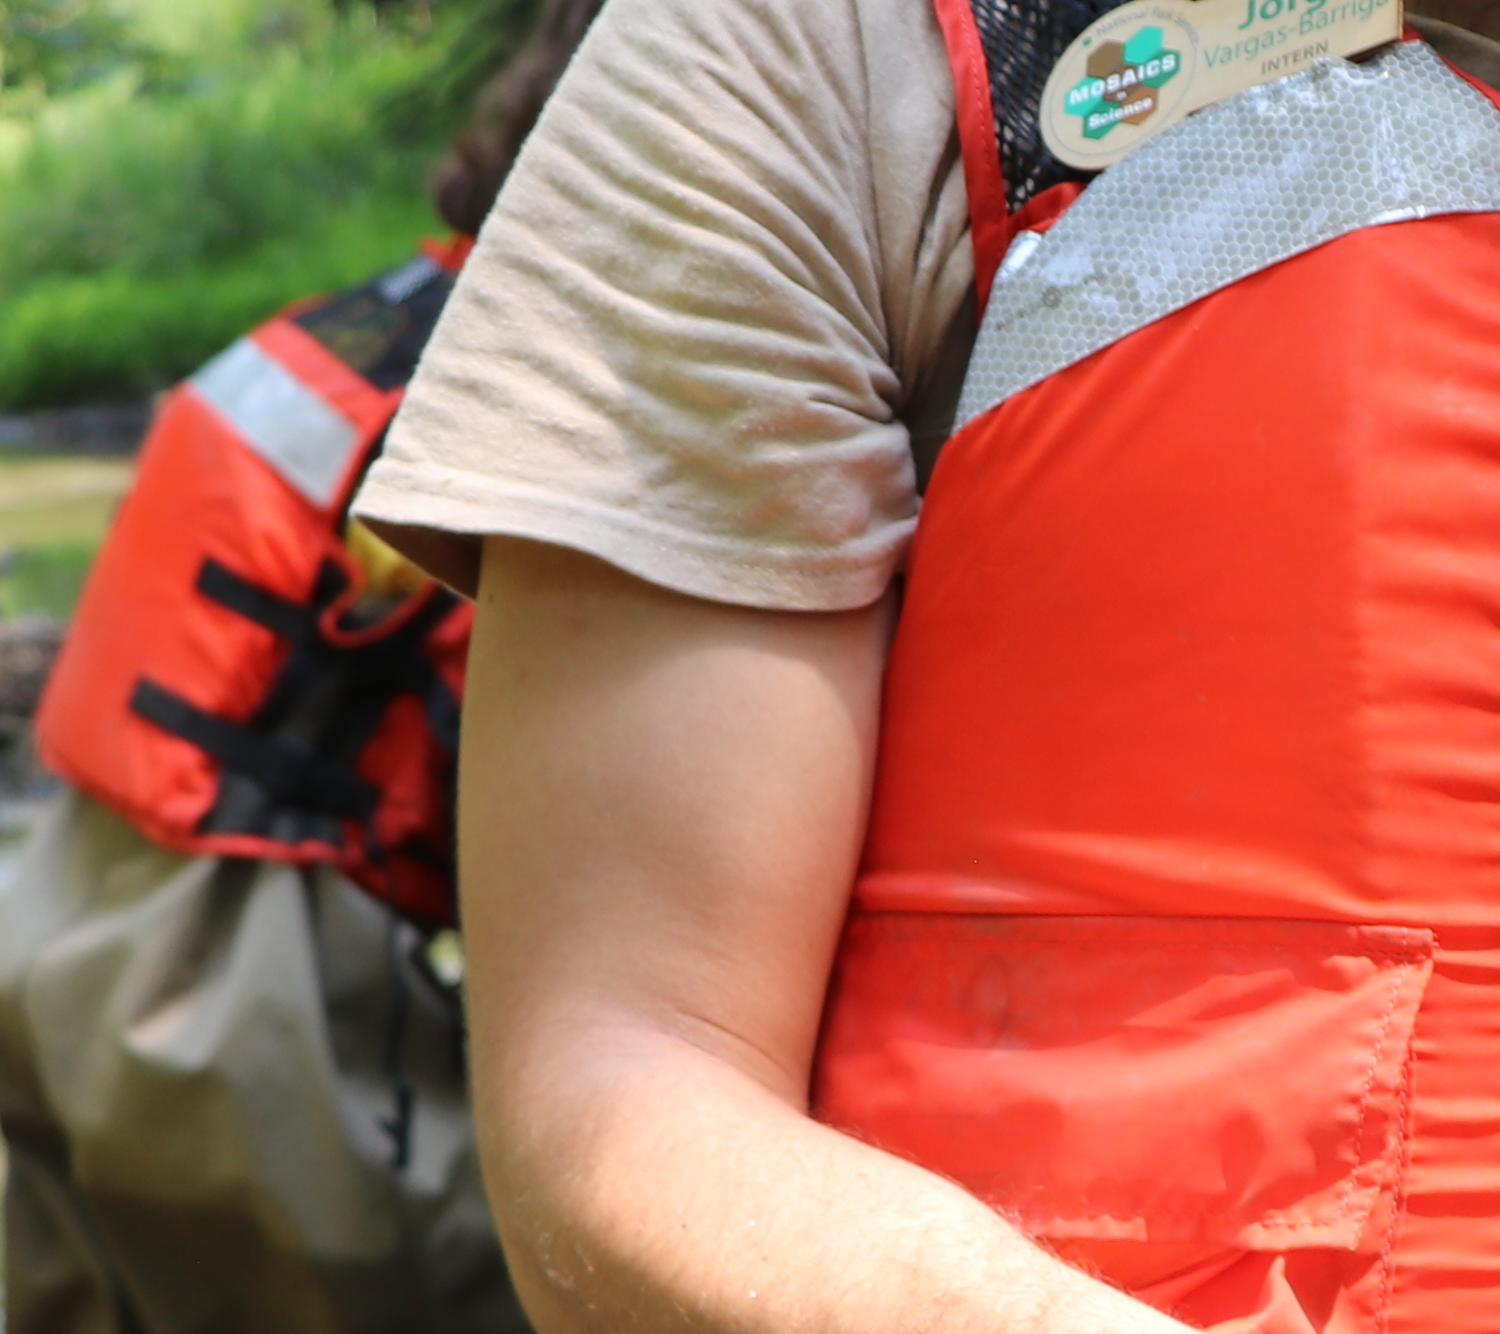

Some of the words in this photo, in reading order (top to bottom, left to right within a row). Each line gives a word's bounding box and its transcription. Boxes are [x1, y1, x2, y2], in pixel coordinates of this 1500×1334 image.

[1260, 40, 1329, 75] INTERN
[1069, 53, 1177, 105] MOSAICS
[1087, 97, 1154, 129] Science
